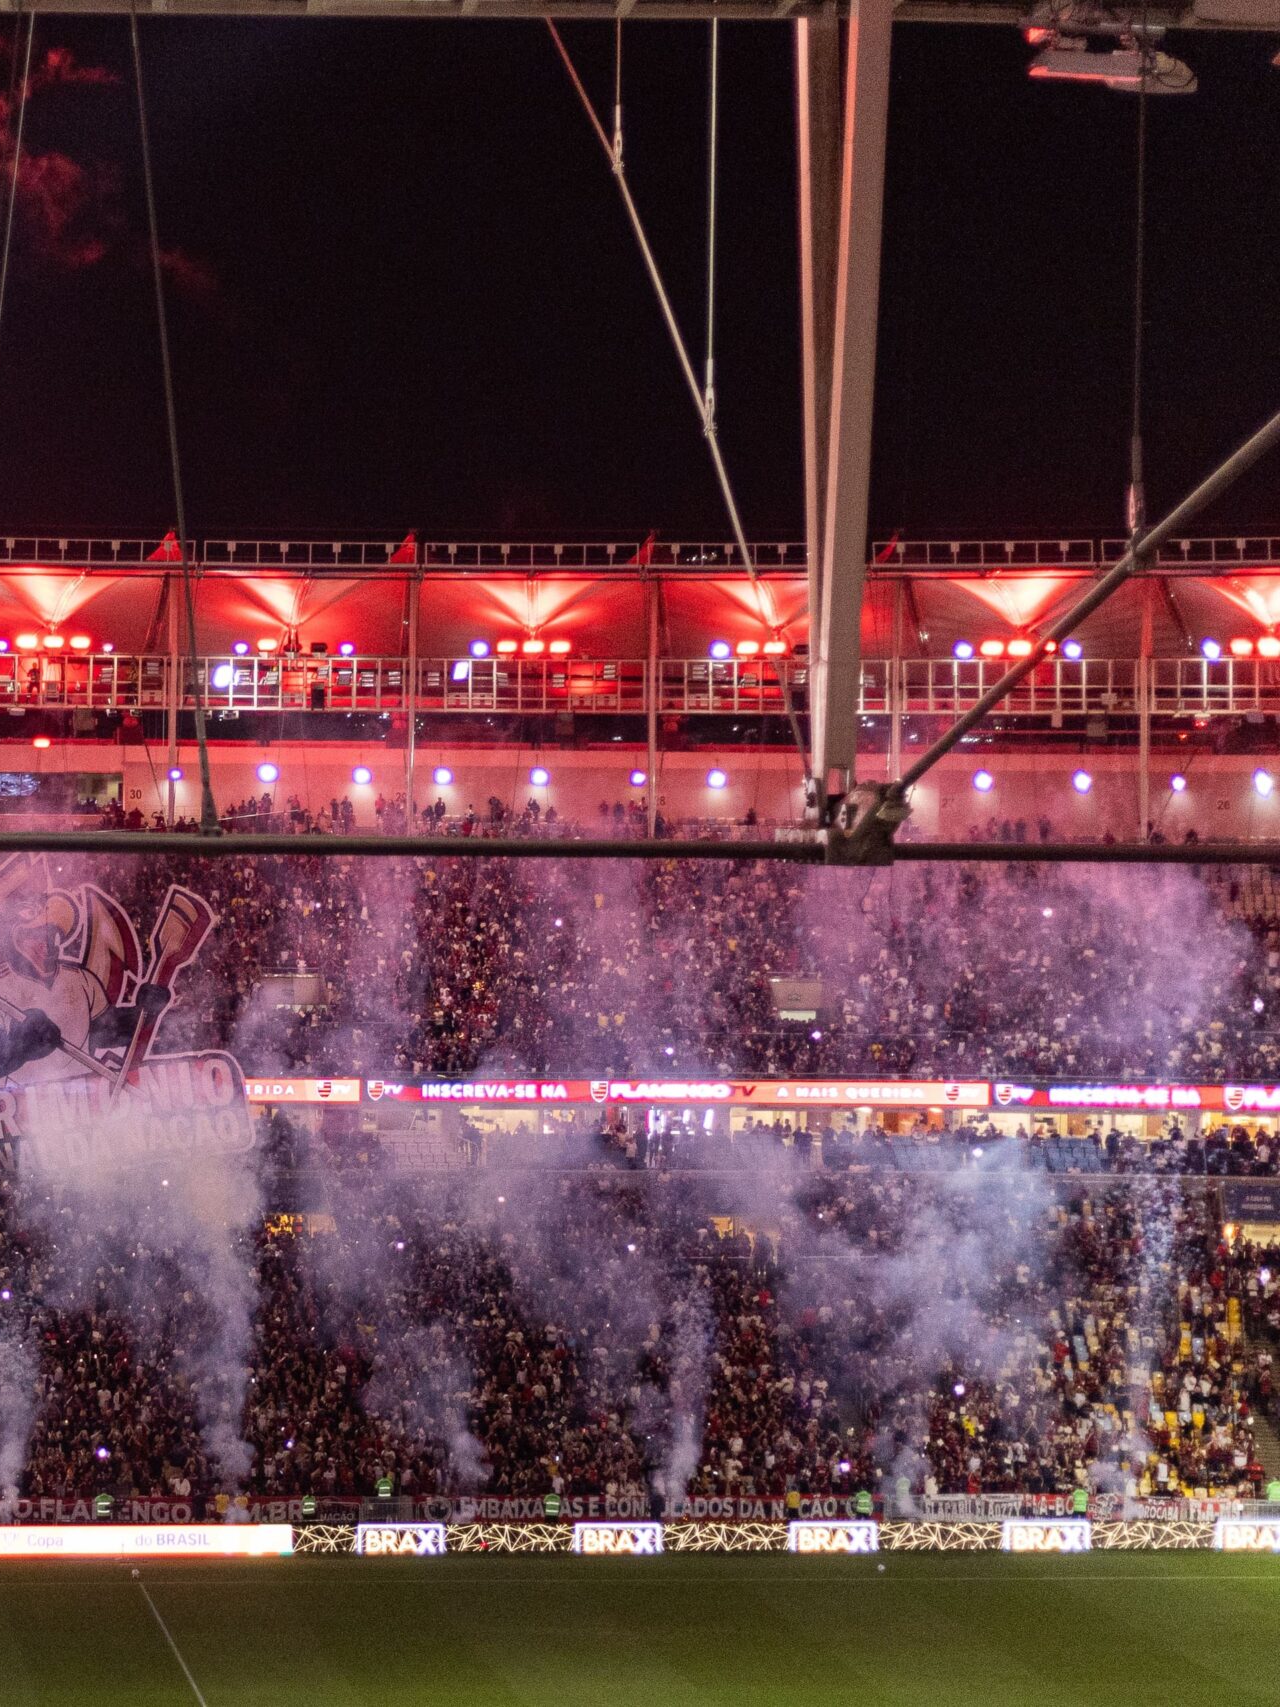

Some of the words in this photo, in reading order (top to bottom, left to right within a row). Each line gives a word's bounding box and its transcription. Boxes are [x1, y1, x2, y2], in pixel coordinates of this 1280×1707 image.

[129, 788, 142, 800] 30
[420, 1083, 537, 1099] INSCREVA-SE
[540, 1083, 568, 1099] NA
[609, 1082, 731, 1099] FLAMENGO
[776, 1086, 790, 1098] A
[795, 1086, 838, 1099] MAIS
[844, 1086, 925, 1100] QUERIDA
[460, 1497, 583, 1519] EMBAIXAAS
[588, 1498, 600, 1518] E
[739, 1498, 766, 1519] DA
[26, 1533, 64, 1549] Copa
[156, 1532, 211, 1546] BRASIL
[365, 1529, 437, 1553] BRAX
[583, 1529, 654, 1552] BRAX
[797, 1527, 870, 1551] BRAX
[1012, 1526, 1083, 1550] BRAX
